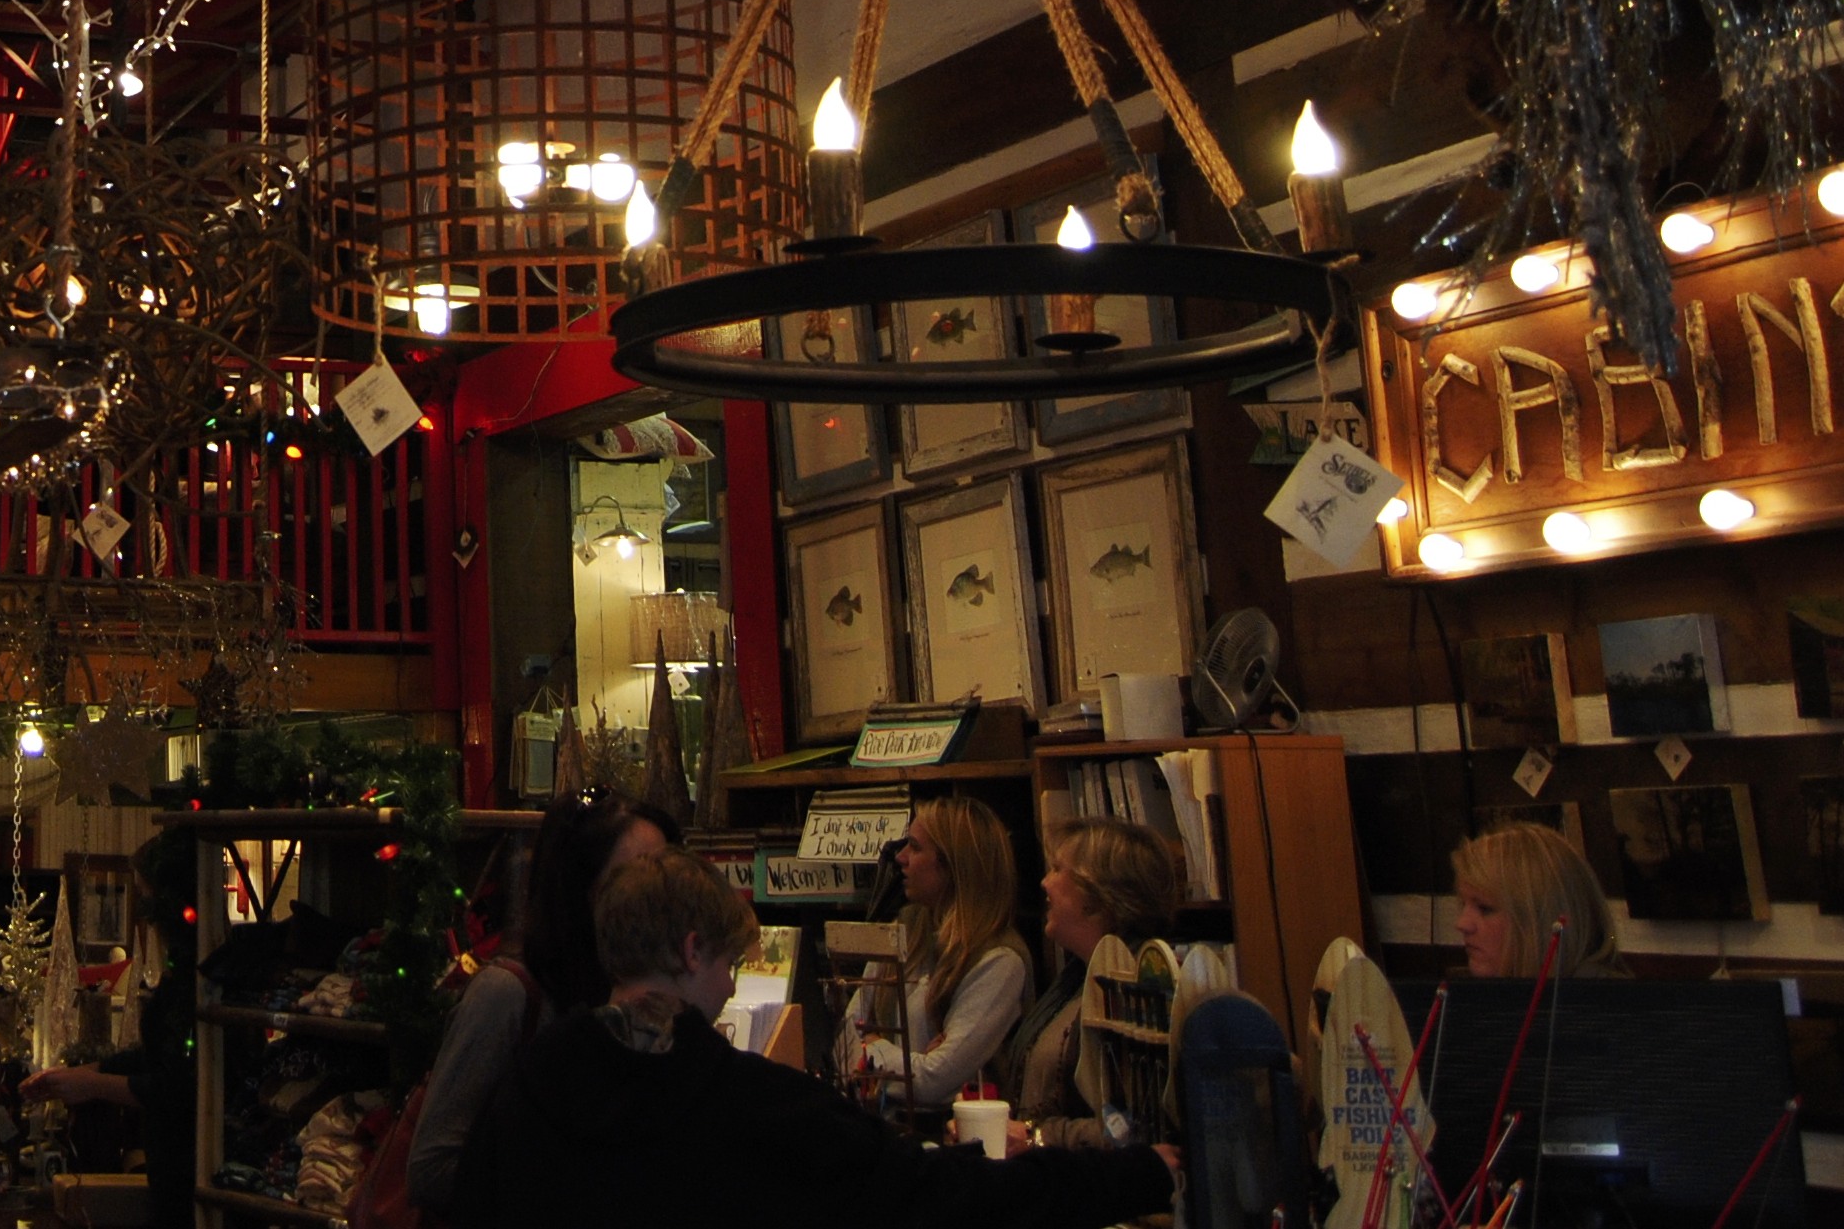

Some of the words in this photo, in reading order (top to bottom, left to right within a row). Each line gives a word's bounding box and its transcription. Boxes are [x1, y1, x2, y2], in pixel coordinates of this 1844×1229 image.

[1424, 277, 1844, 503] CABIN
[810, 817, 821, 836] I
[814, 836, 825, 856] I
[768, 862, 828, 891] Welcome
[831, 862, 848, 888] to
